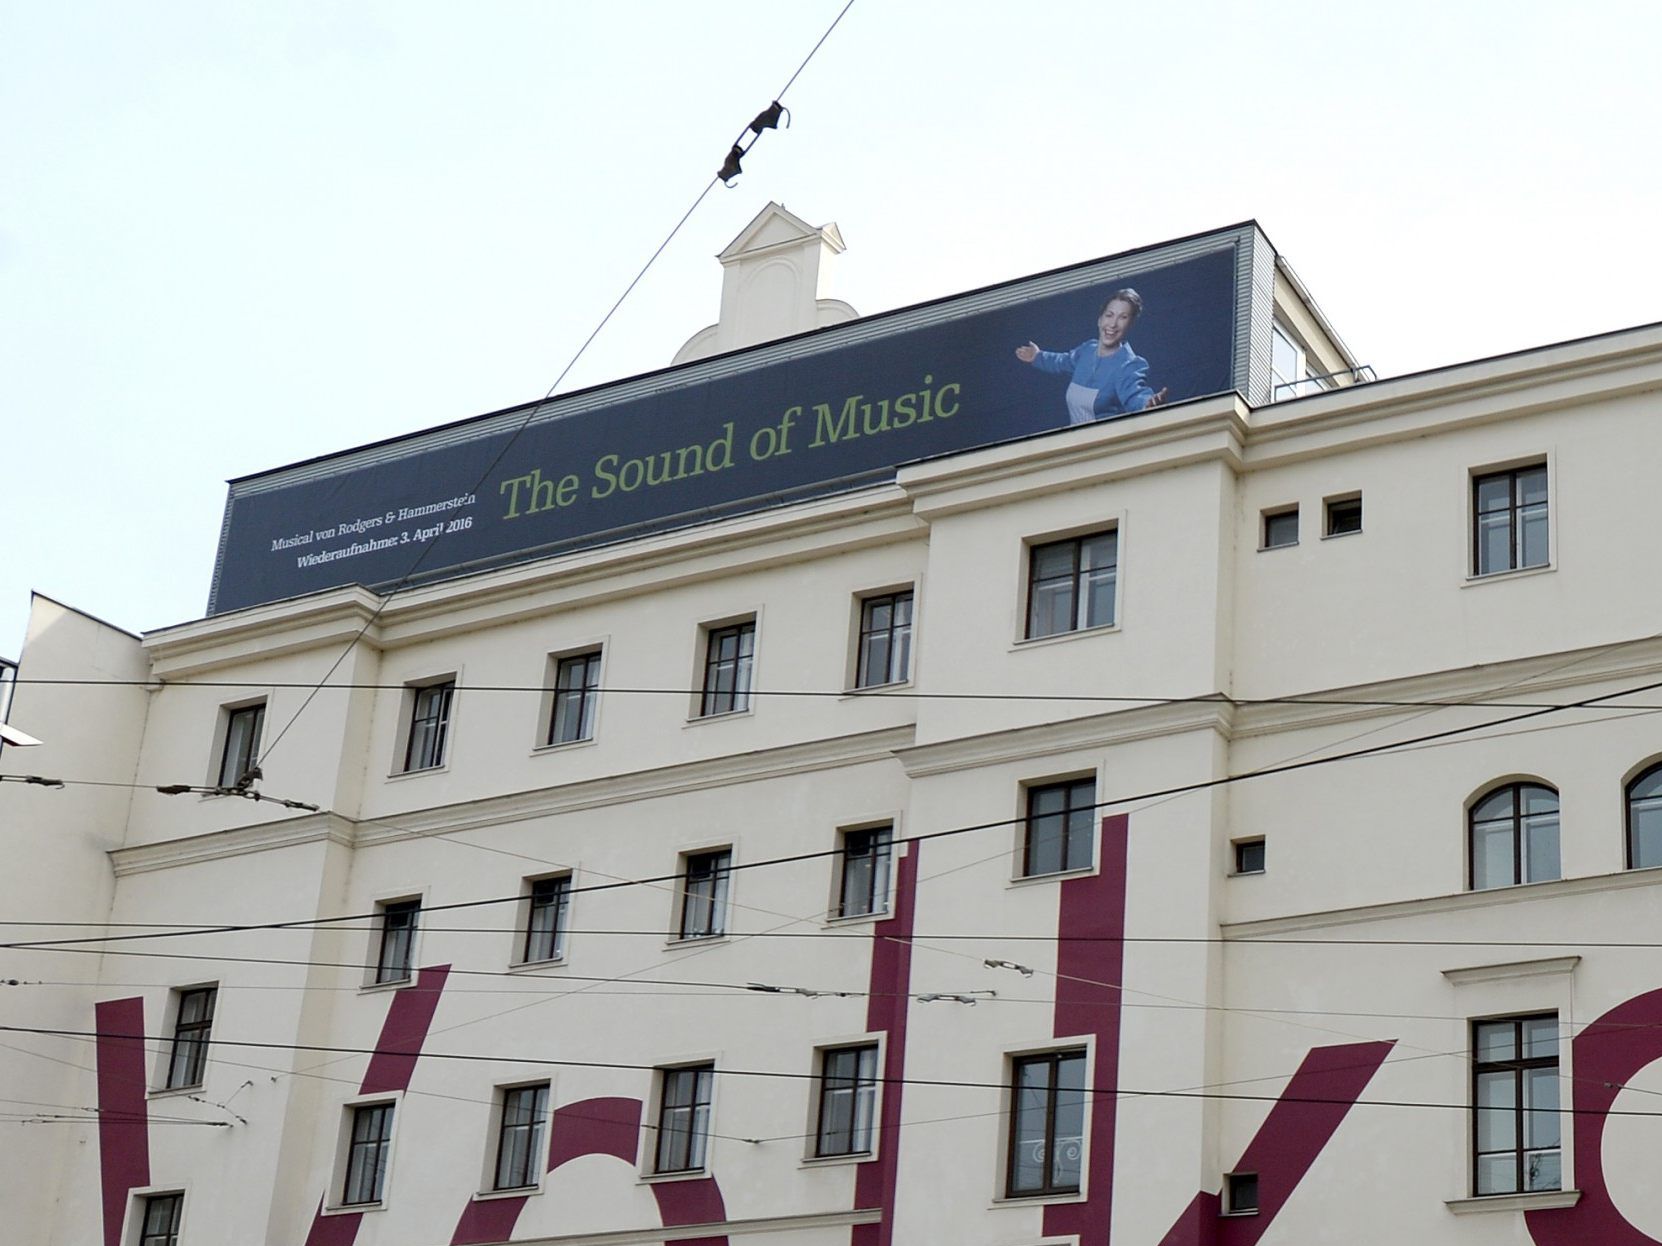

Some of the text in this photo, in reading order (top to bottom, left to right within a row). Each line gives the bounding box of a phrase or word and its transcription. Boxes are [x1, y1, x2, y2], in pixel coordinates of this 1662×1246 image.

[499, 374, 961, 520] The Sound of Music
[270, 493, 476, 552] Musical von Rodgers & Hammerstein
[296, 516, 474, 568] Wiederaufnahme: 3. April 2016
